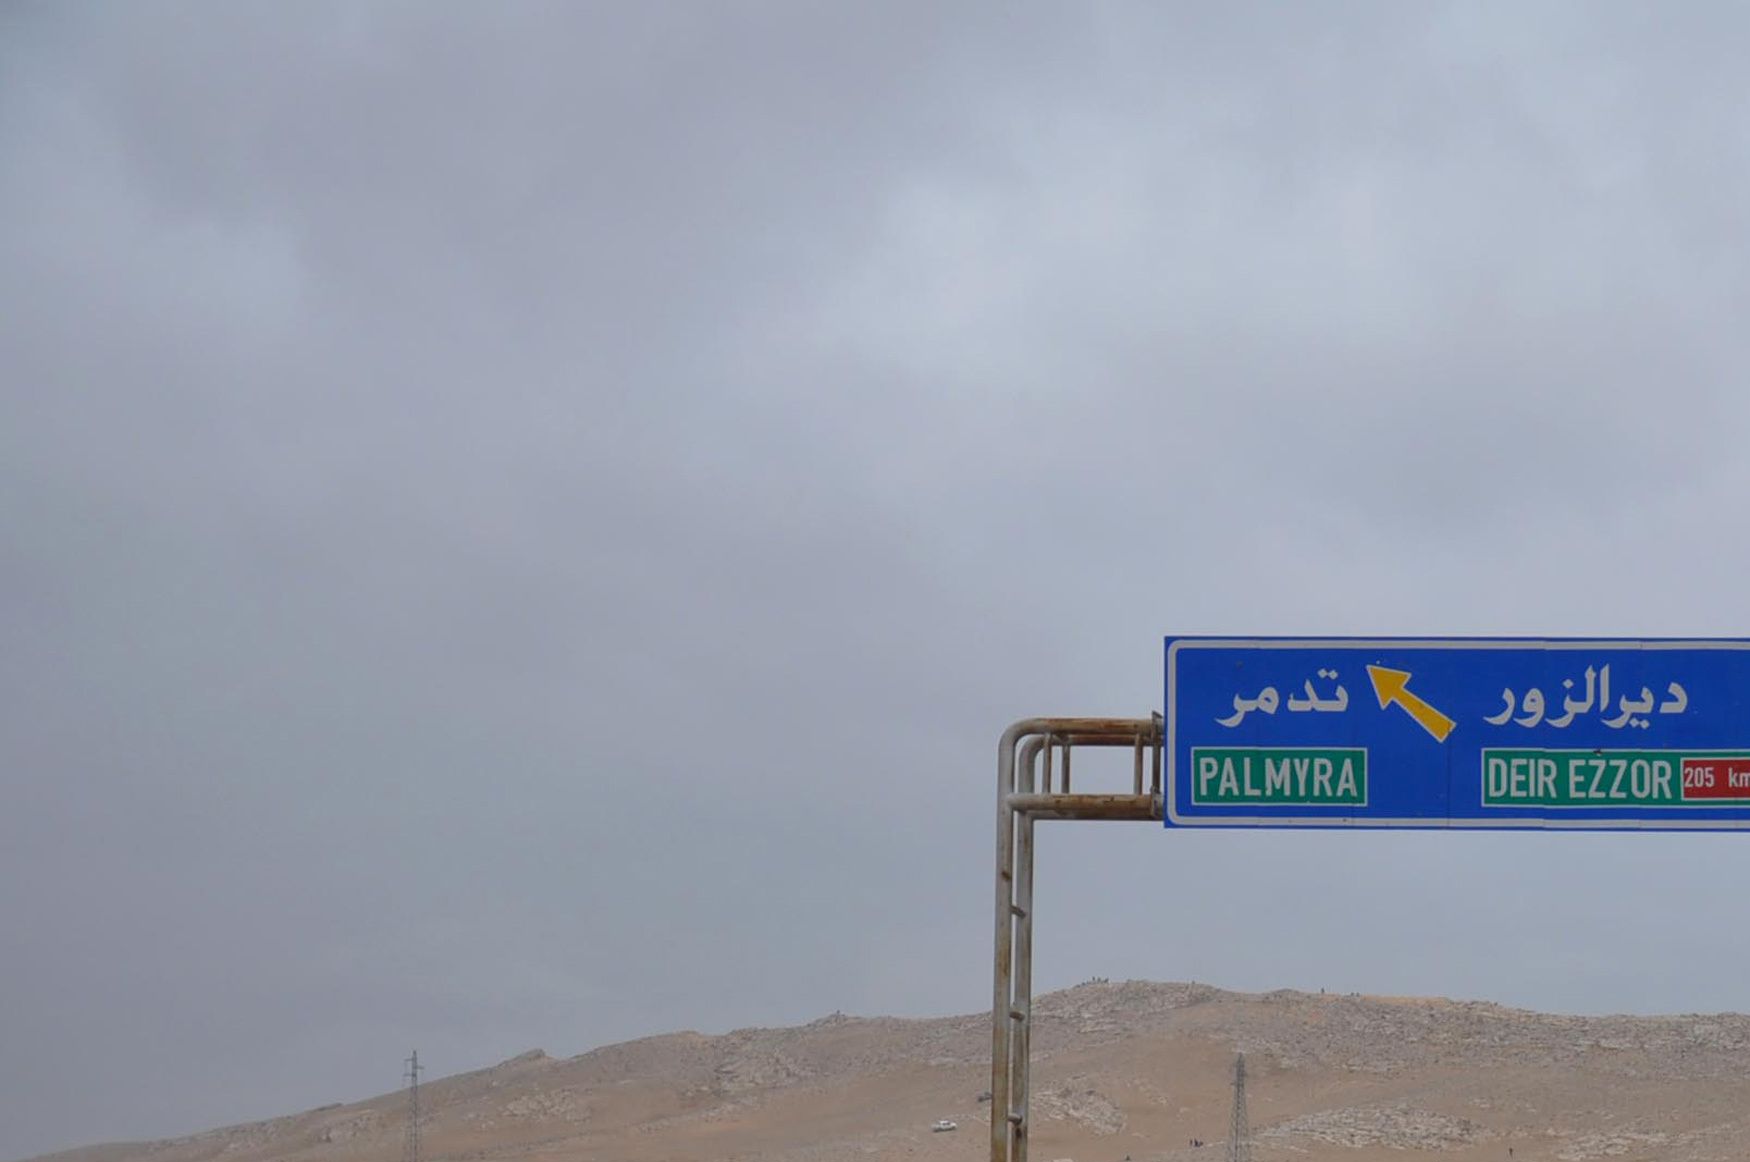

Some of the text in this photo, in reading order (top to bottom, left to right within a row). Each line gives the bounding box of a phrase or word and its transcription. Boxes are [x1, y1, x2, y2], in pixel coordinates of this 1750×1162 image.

[1215, 668, 1349, 728] تدمر
[1199, 757, 1358, 797] PALMYRA
[1488, 758, 1672, 799] DEIR EZZOR
[1684, 766, 1715, 788] 205
